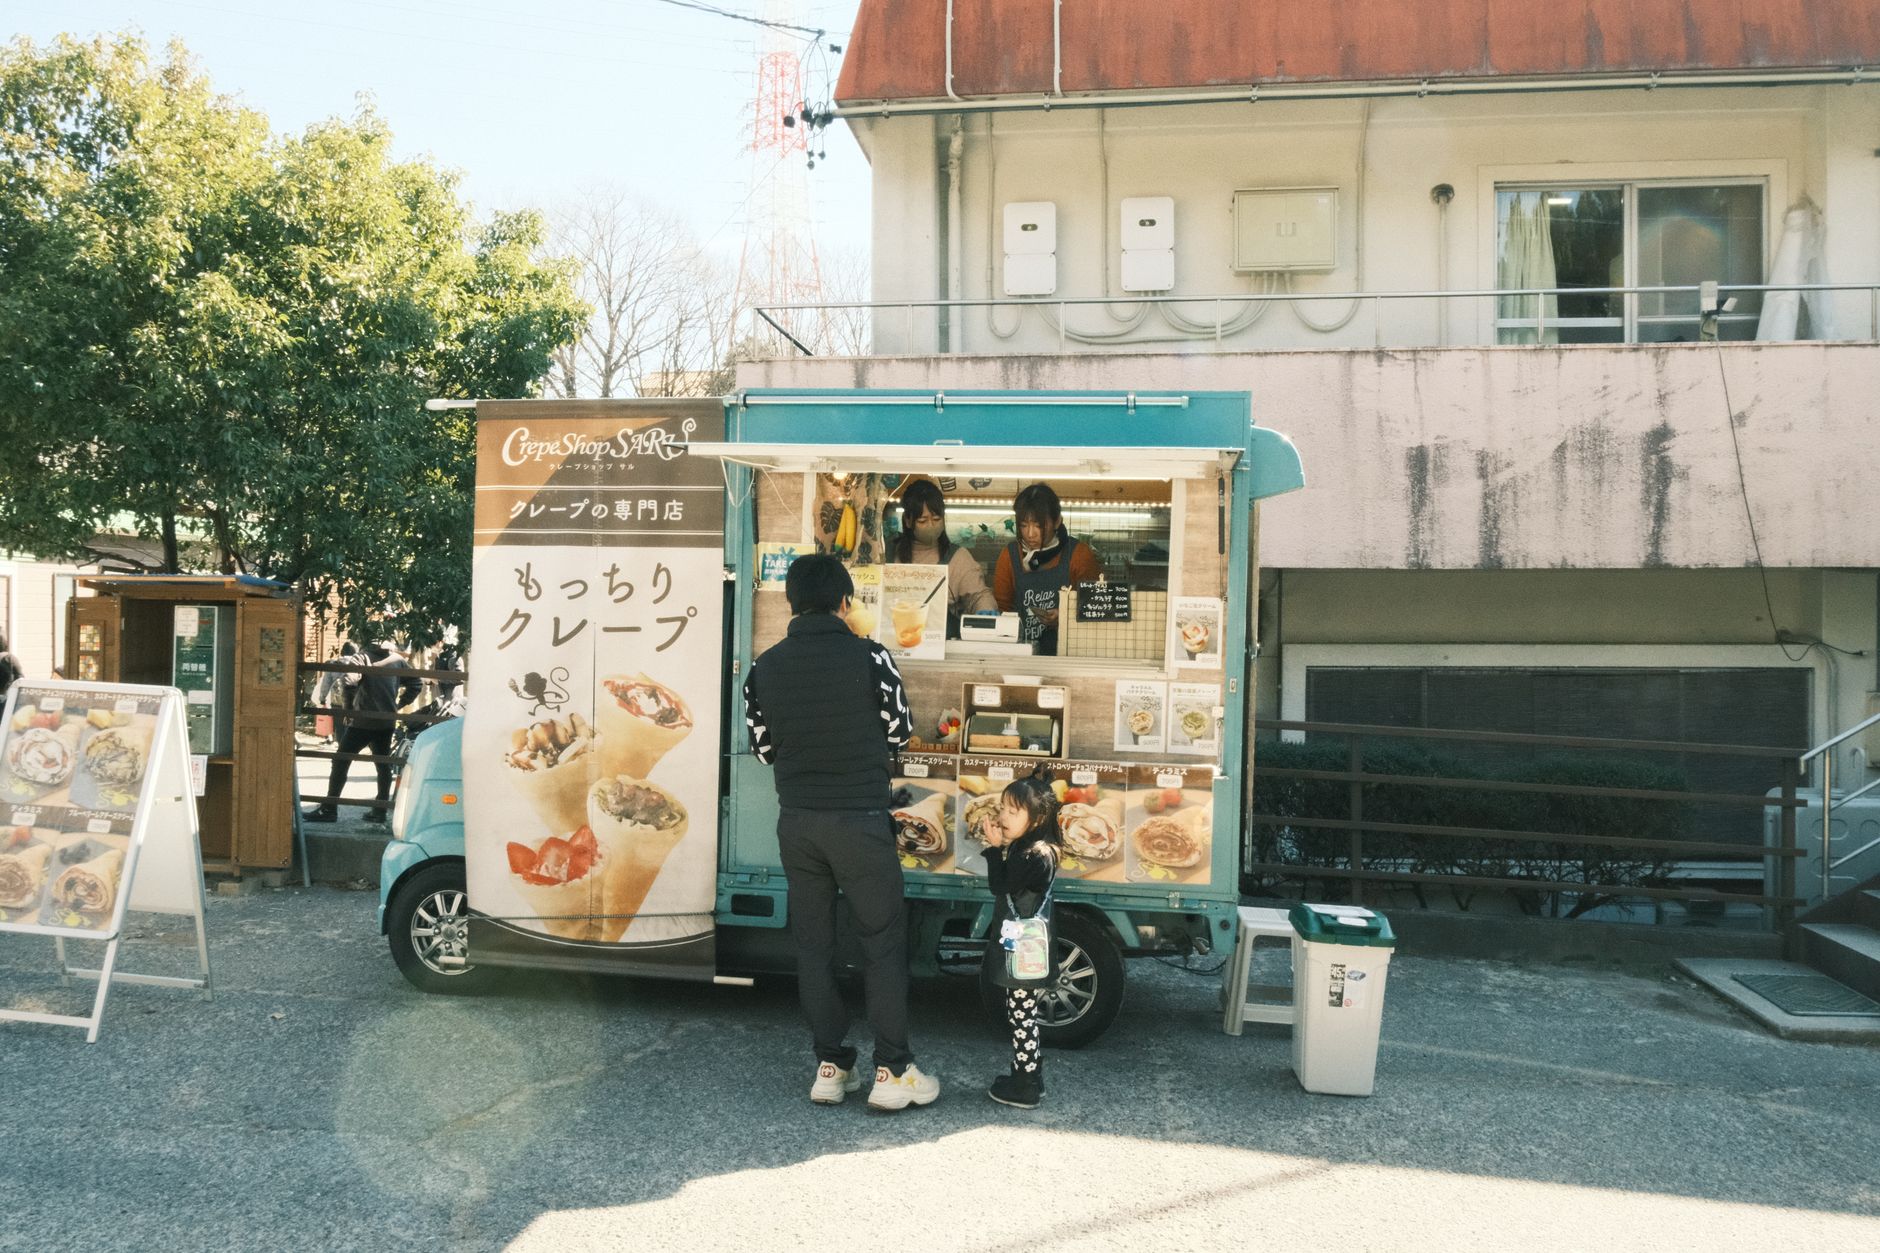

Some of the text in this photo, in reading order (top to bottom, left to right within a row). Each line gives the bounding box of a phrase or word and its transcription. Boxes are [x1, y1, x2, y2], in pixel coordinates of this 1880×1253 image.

[509, 499, 685, 521] クレープの専門店
[765, 559, 788, 568] TAKE
[514, 562, 673, 605] もっちり
[497, 605, 698, 653] クレープ
[1152, 766, 1188, 775] ティラミス
[10, 804, 42, 814] ティラミス
